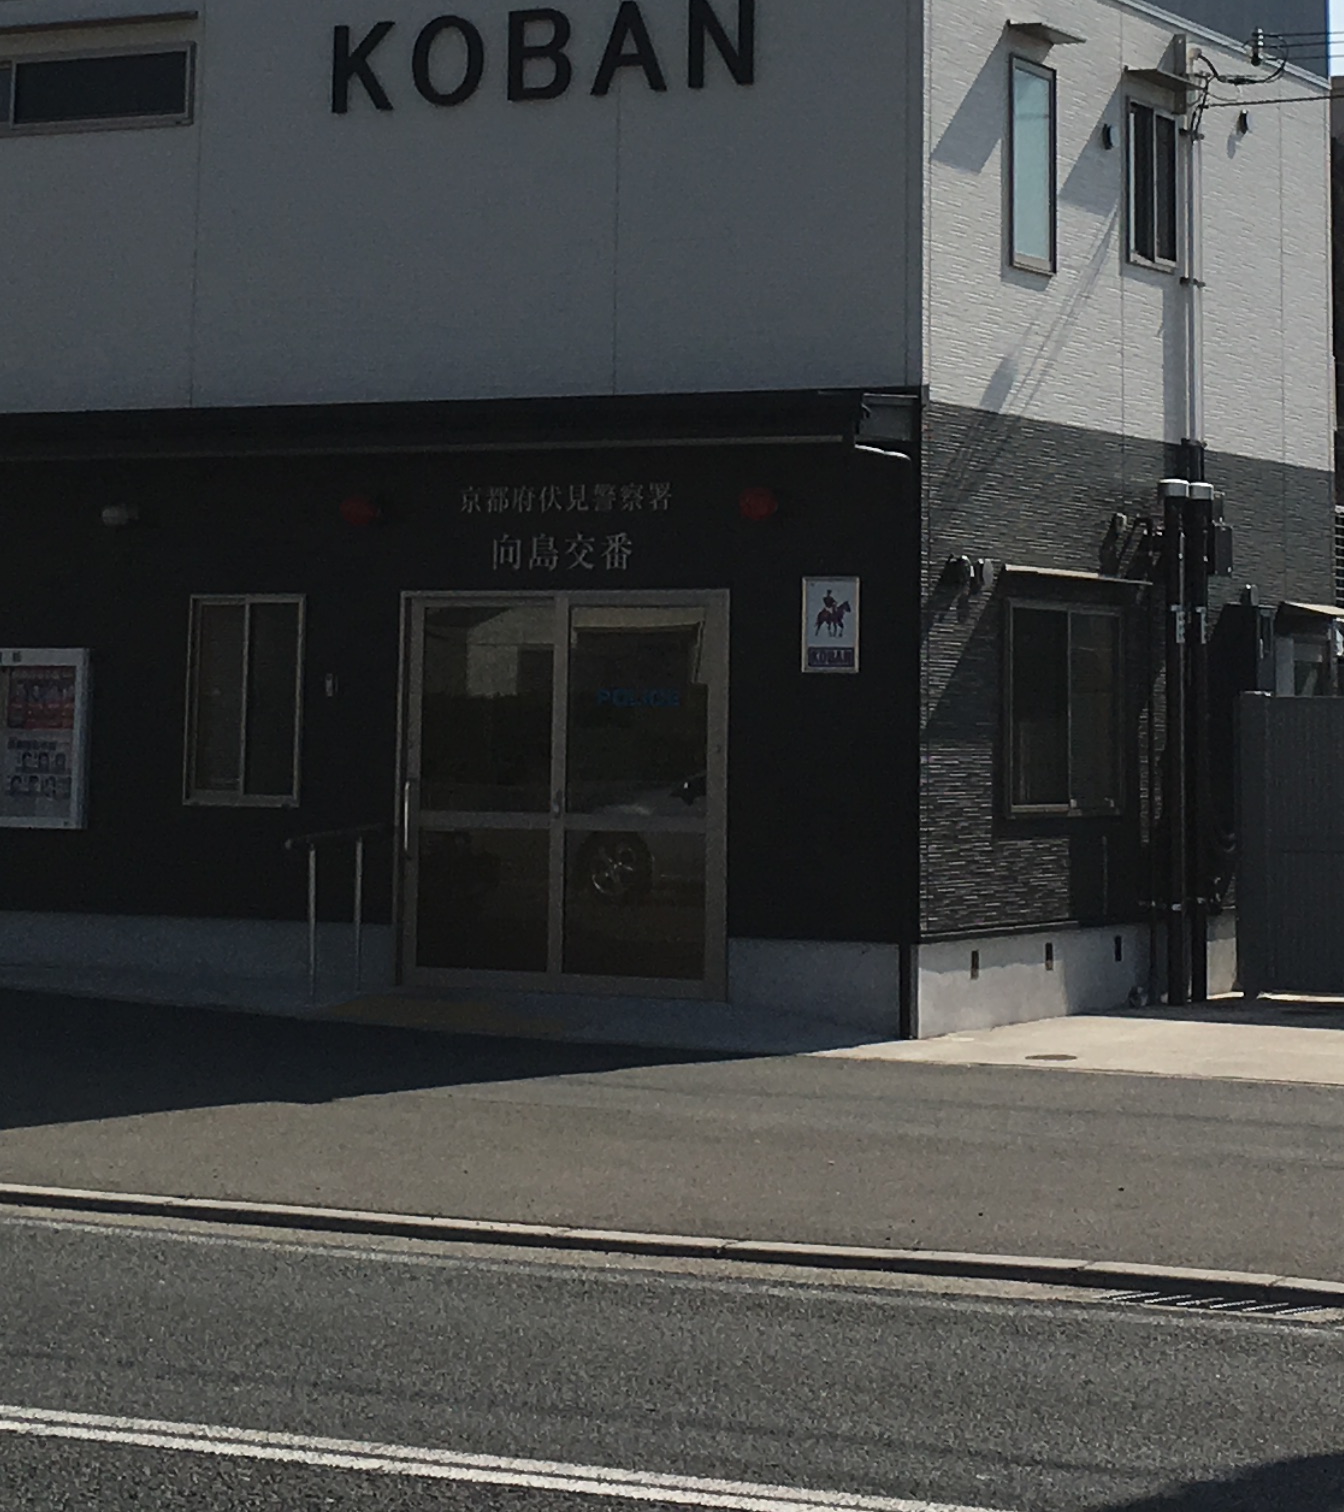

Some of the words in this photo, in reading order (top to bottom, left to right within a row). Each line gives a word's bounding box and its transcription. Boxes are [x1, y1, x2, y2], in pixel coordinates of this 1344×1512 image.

[460, 482, 672, 514] 京都府伏見警察署
[493, 532, 633, 571] 向島交番
